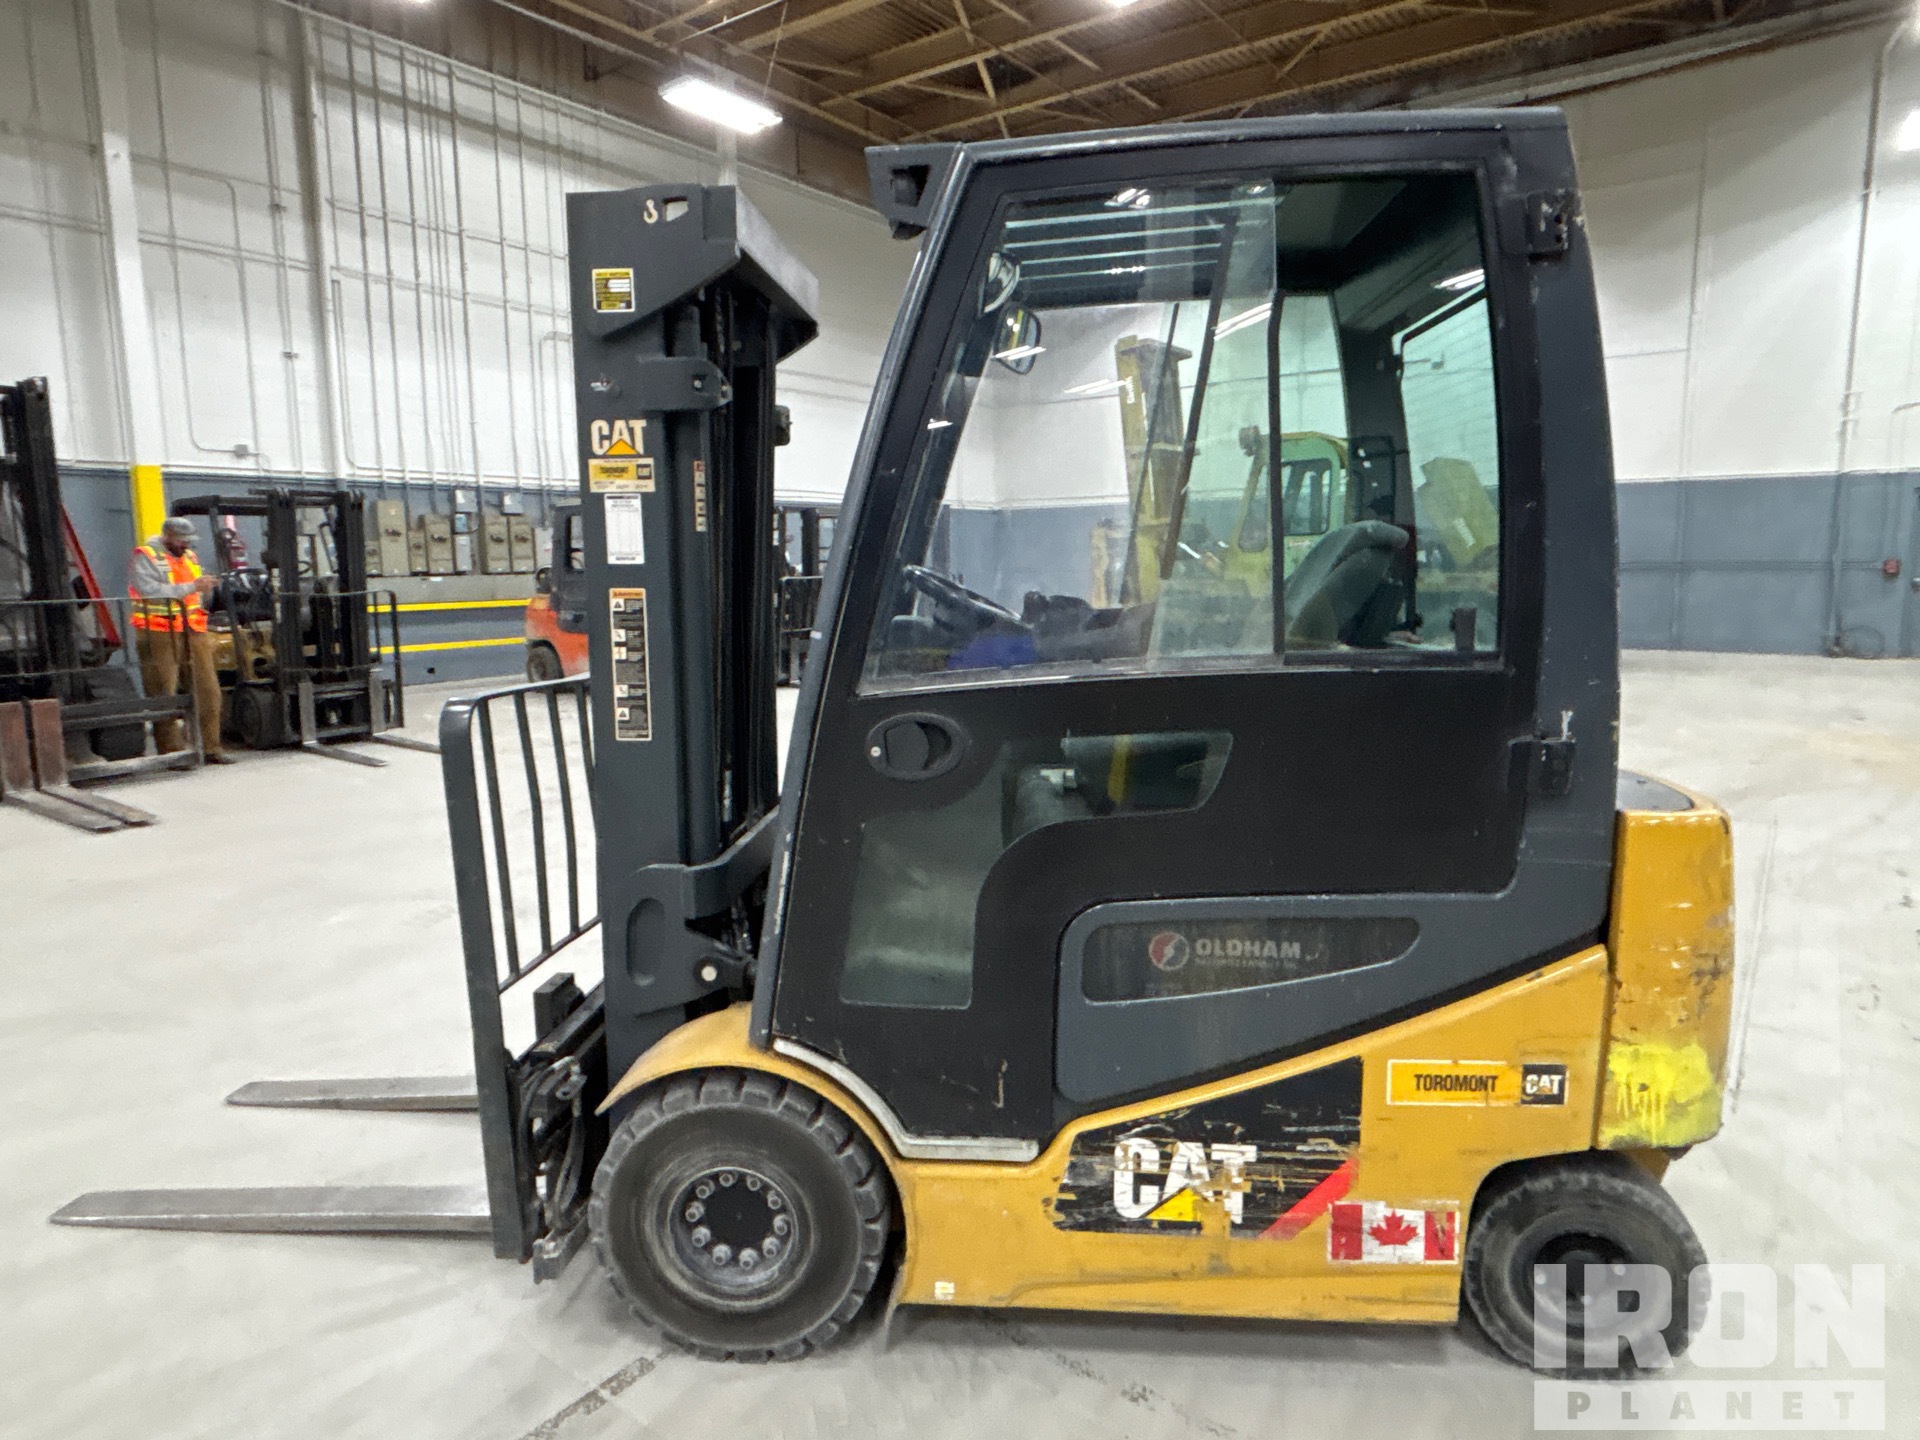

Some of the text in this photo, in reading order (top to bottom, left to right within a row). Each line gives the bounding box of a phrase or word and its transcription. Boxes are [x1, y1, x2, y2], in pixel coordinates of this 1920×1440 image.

[590, 419, 647, 455] CAT
[1194, 938, 1301, 959] OLDHAM
[1414, 1074, 1563, 1095] TOROMONT CAT
[1113, 1137, 1257, 1224] CAT
